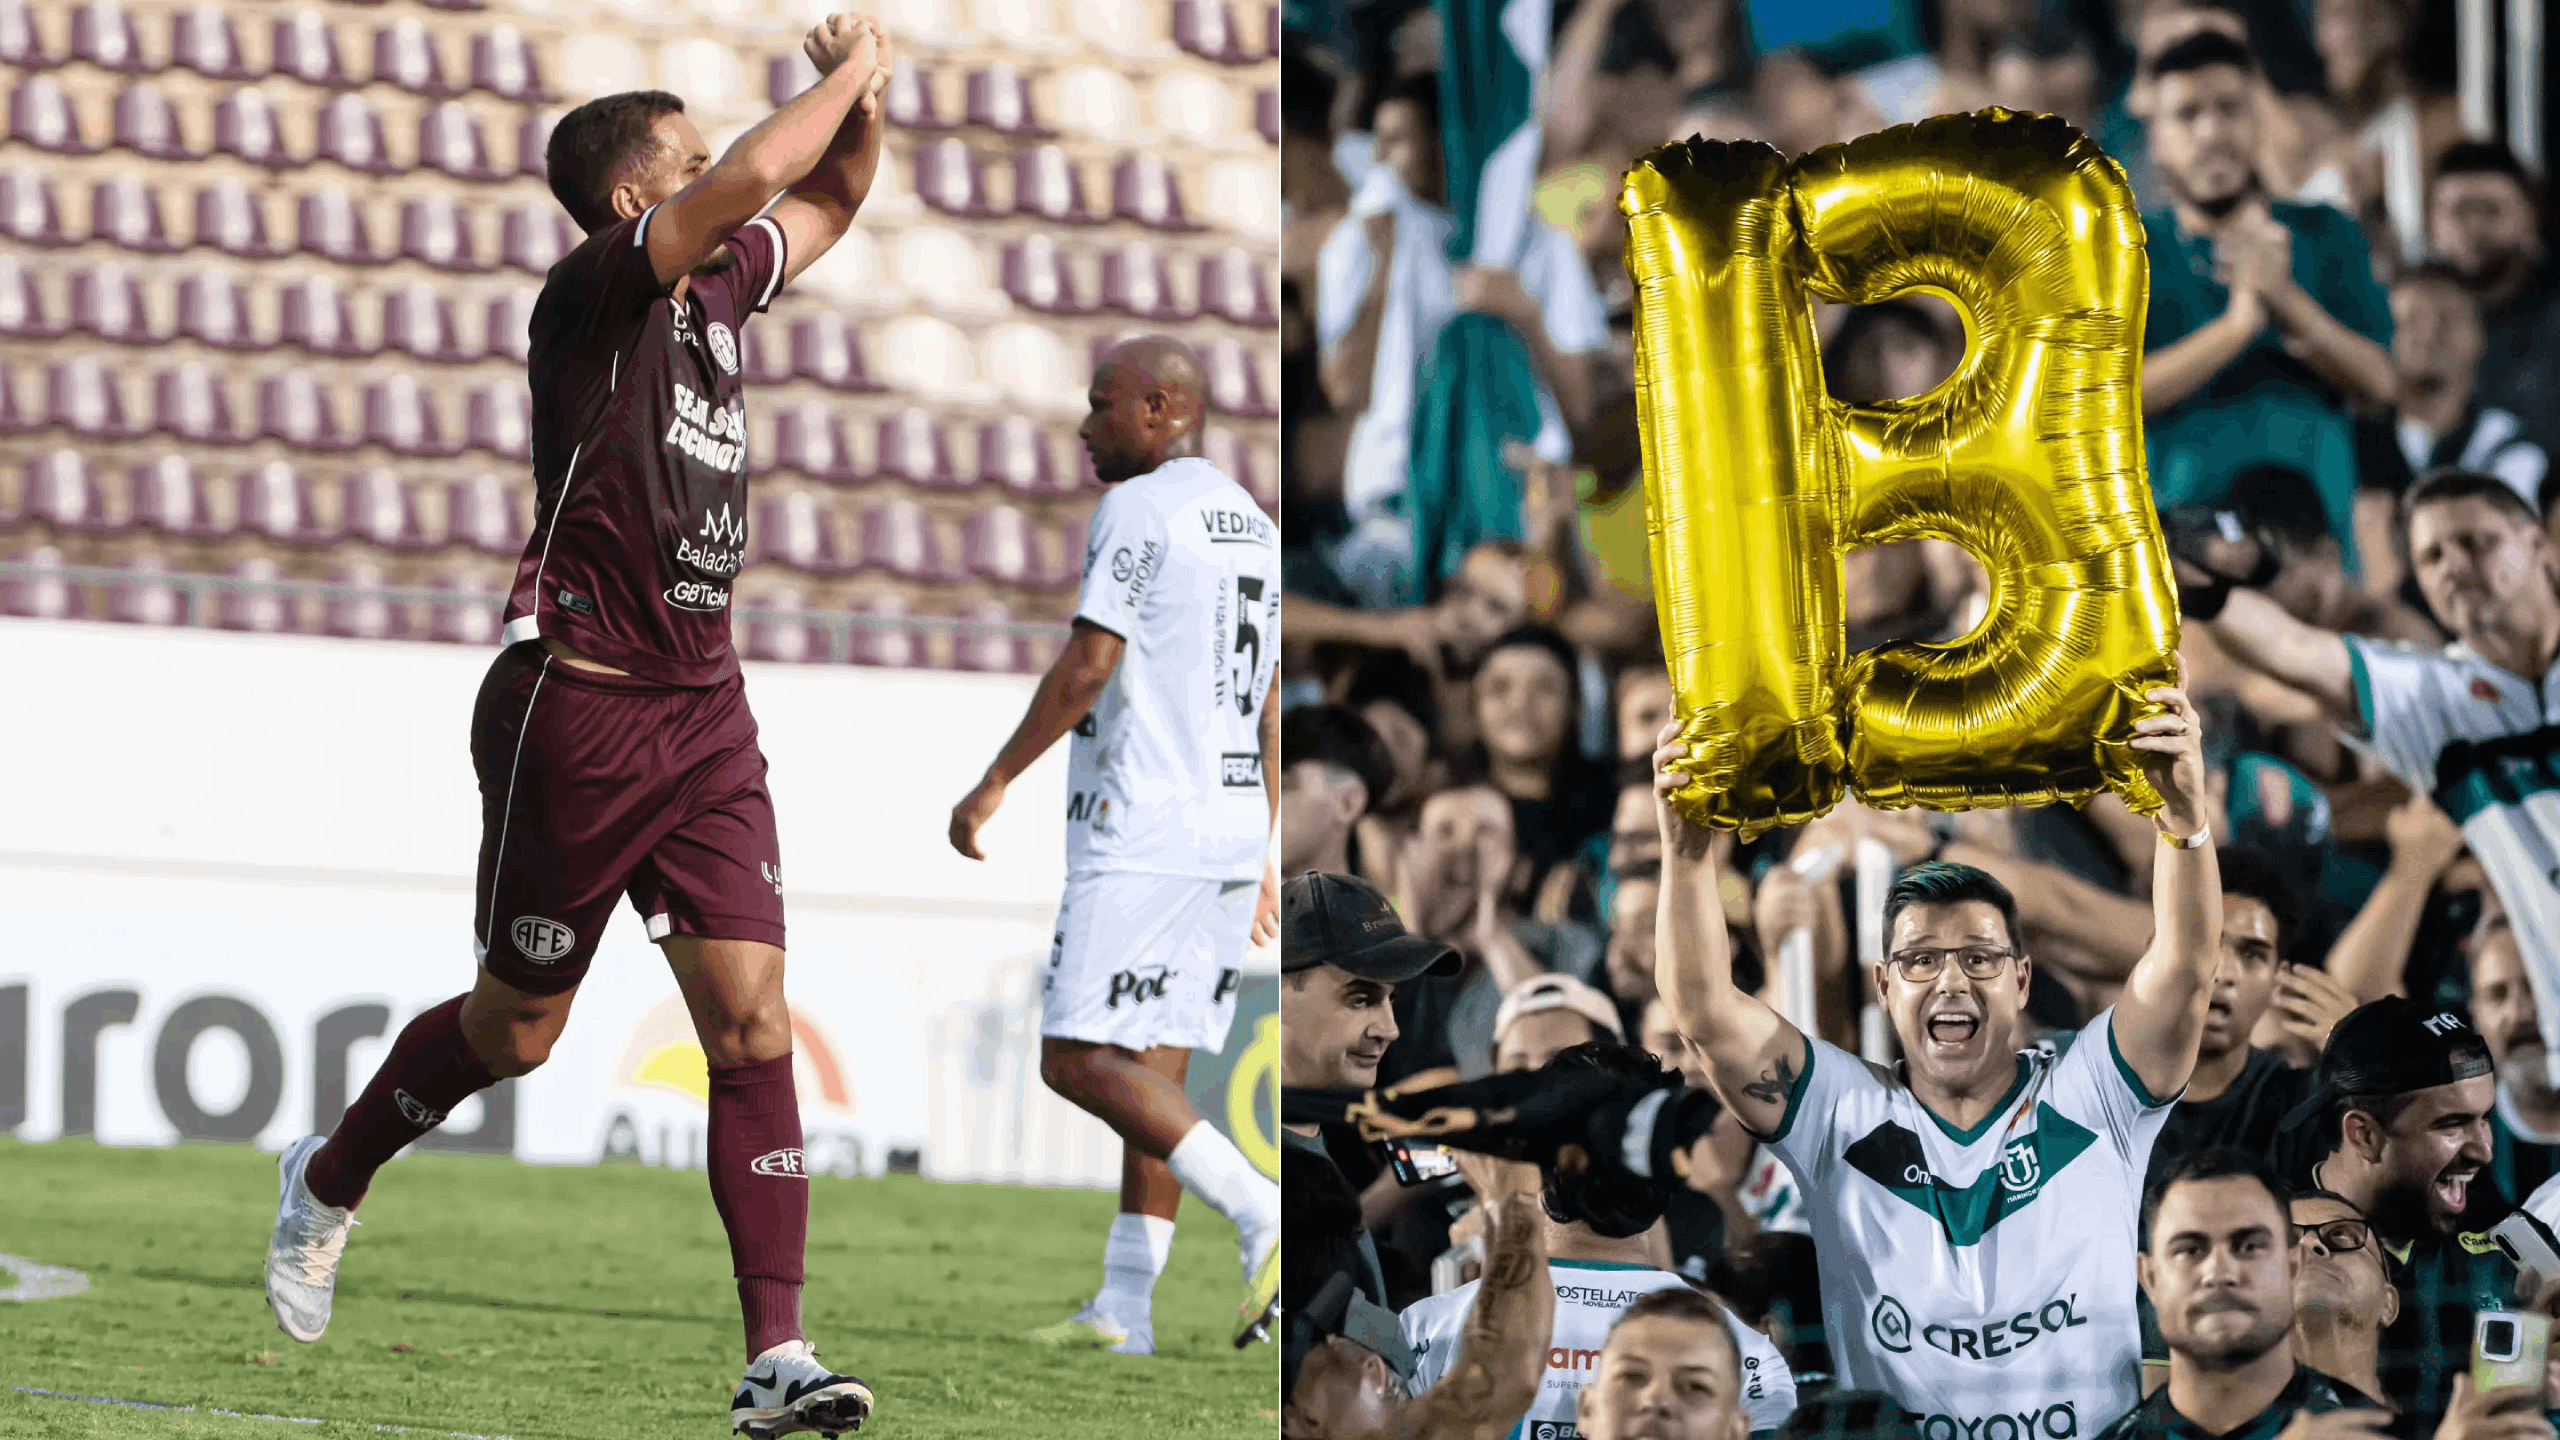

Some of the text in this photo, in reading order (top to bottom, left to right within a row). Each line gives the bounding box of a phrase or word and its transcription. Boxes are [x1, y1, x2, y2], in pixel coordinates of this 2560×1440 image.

[1619, 105, 2181, 842] B
[1125, 539, 1162, 607] KRONA
[1234, 575, 1265, 716] 5
[516, 921, 567, 954] AFE
[760, 1151, 804, 1173] AF
[1582, 1301, 1621, 1309] MOVELARIA
[1923, 1292, 2088, 1360] CRESOL
